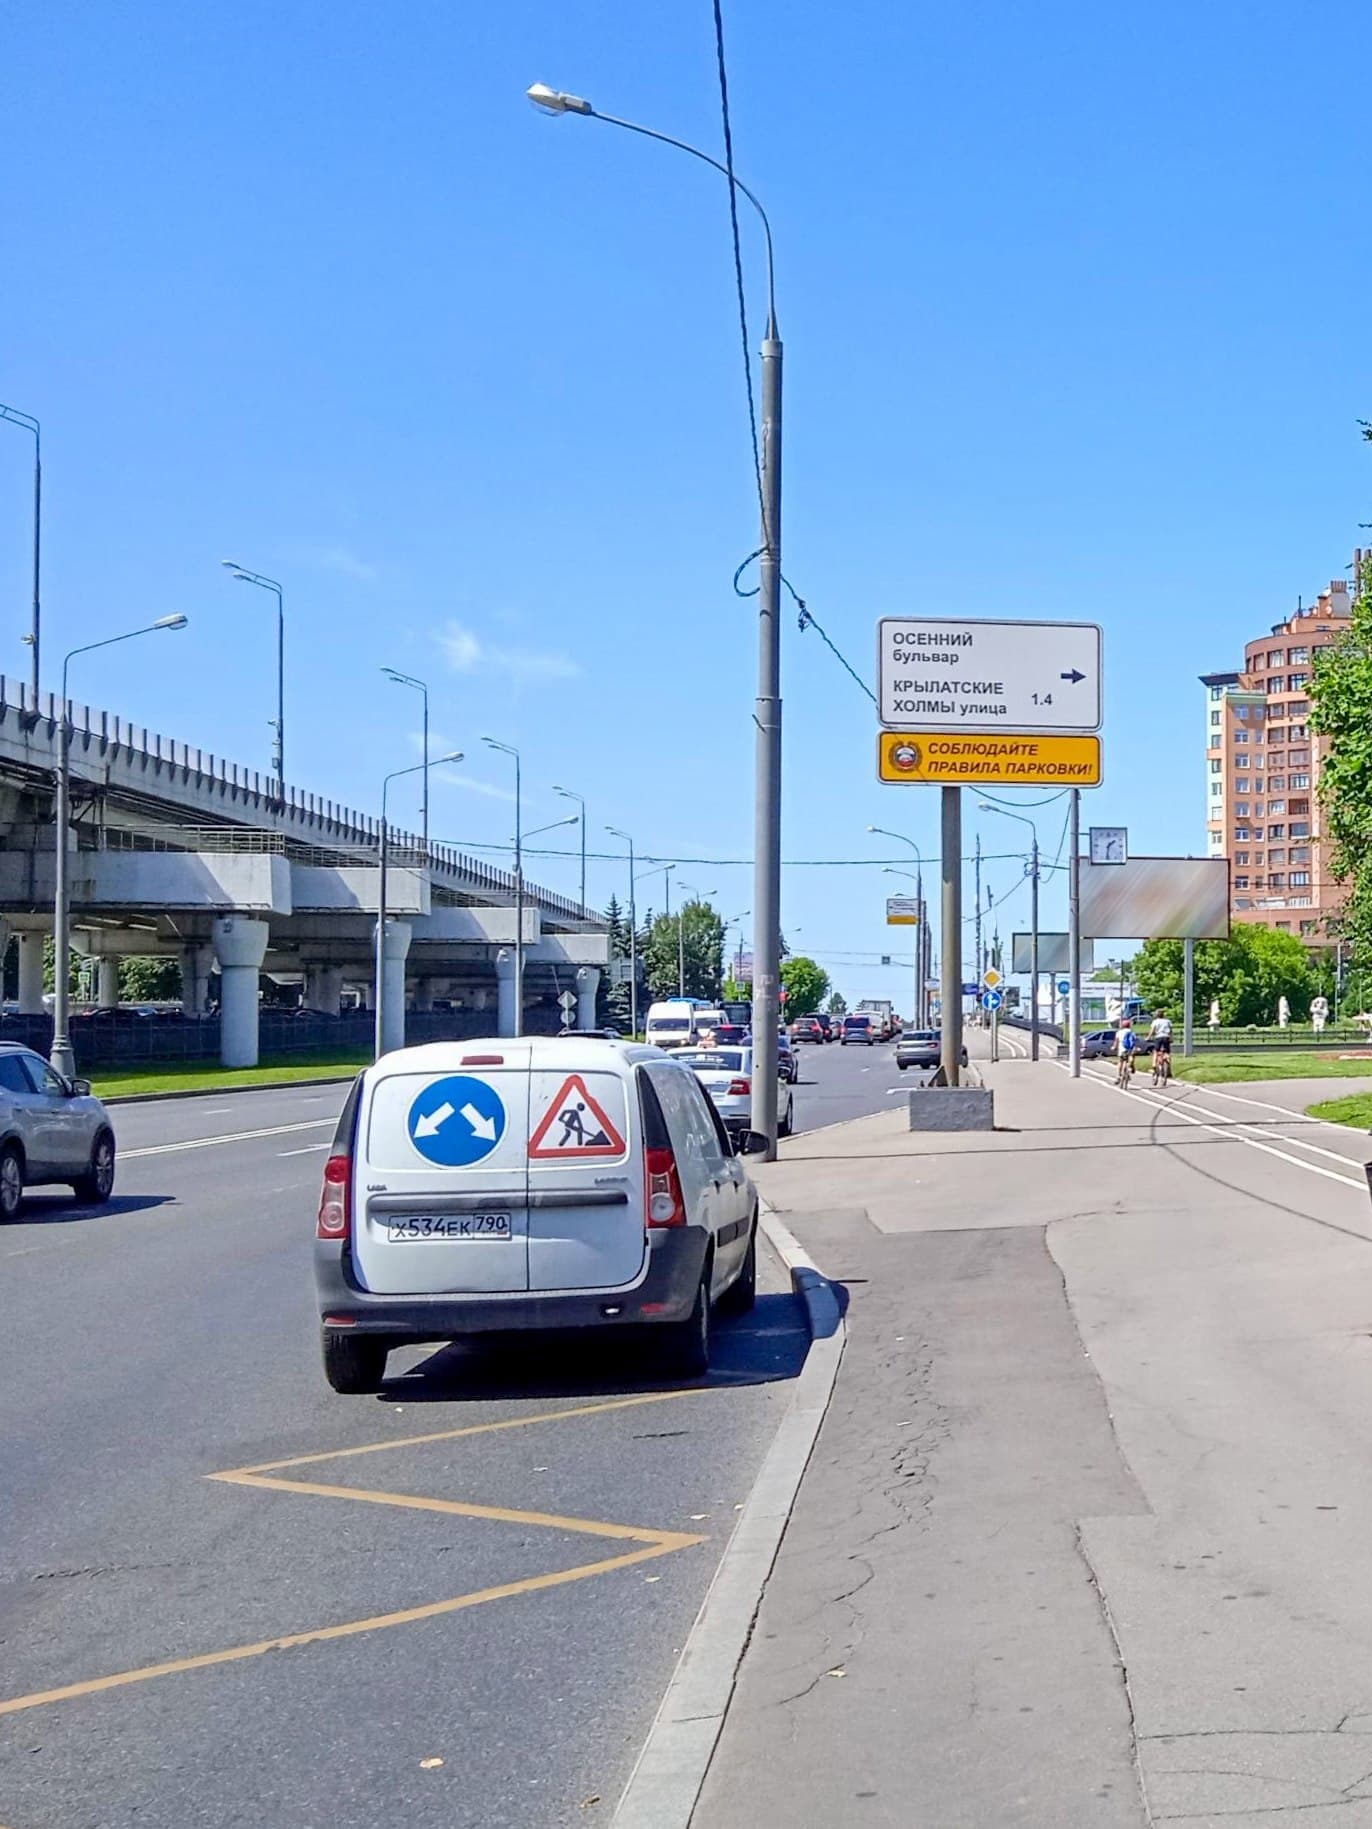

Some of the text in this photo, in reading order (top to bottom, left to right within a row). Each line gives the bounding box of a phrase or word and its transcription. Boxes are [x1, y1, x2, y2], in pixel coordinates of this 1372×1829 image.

[893, 632, 973, 646] ОСЕННИЙ
[893, 650, 959, 665] бульвар
[893, 681, 1004, 695] КРЫЛАТСКИЕ
[1031, 693, 1053, 706] 1.4
[893, 700, 1007, 717] ХОЛМЫ улица
[928, 742, 1039, 757] СОБЛЮДАЙТЕ
[928, 761, 1092, 776] ПРАВИЛА ПАРКОВКИ!
[476, 1216, 506, 1230] 790
